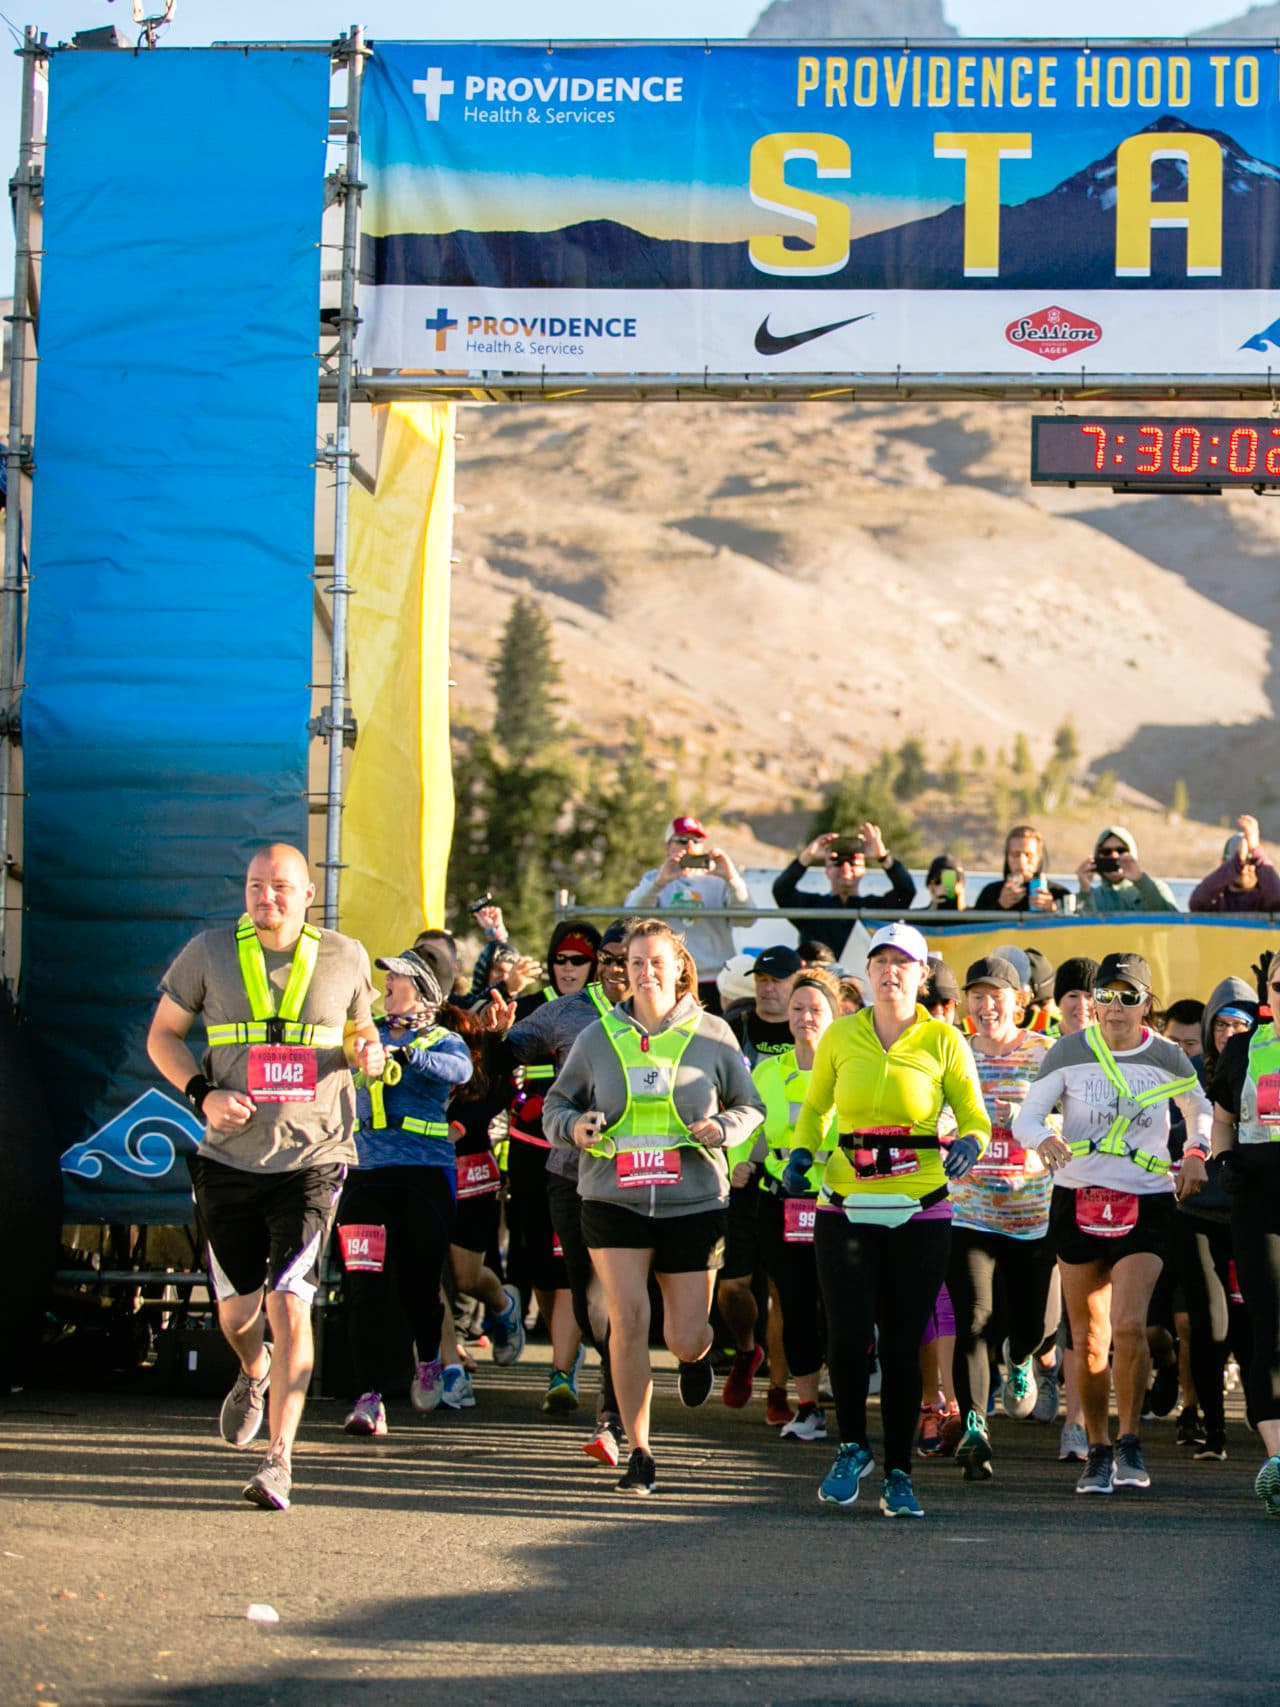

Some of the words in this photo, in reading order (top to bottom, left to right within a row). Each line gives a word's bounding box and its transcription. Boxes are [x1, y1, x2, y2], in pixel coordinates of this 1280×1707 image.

[465, 76, 684, 102] PROVIDENCE
[797, 56, 1058, 107] PROVIDENCE
[1076, 56, 1191, 107] HOOD
[1210, 56, 1259, 107] TO
[464, 106, 522, 122] Health
[526, 107, 541, 123] &
[545, 107, 615, 123] Services
[467, 316, 637, 338] PROVIDENCE
[1011, 319, 1097, 341] Session
[466, 340, 511, 353] Health
[514, 341, 525, 353] &
[529, 342, 584, 355] Services
[263, 1063, 304, 1083] 1042
[631, 1151, 665, 1169] 1172
[467, 1164, 490, 1182] 425
[1102, 1204, 1112, 1221] 4
[347, 1239, 369, 1256] 194
